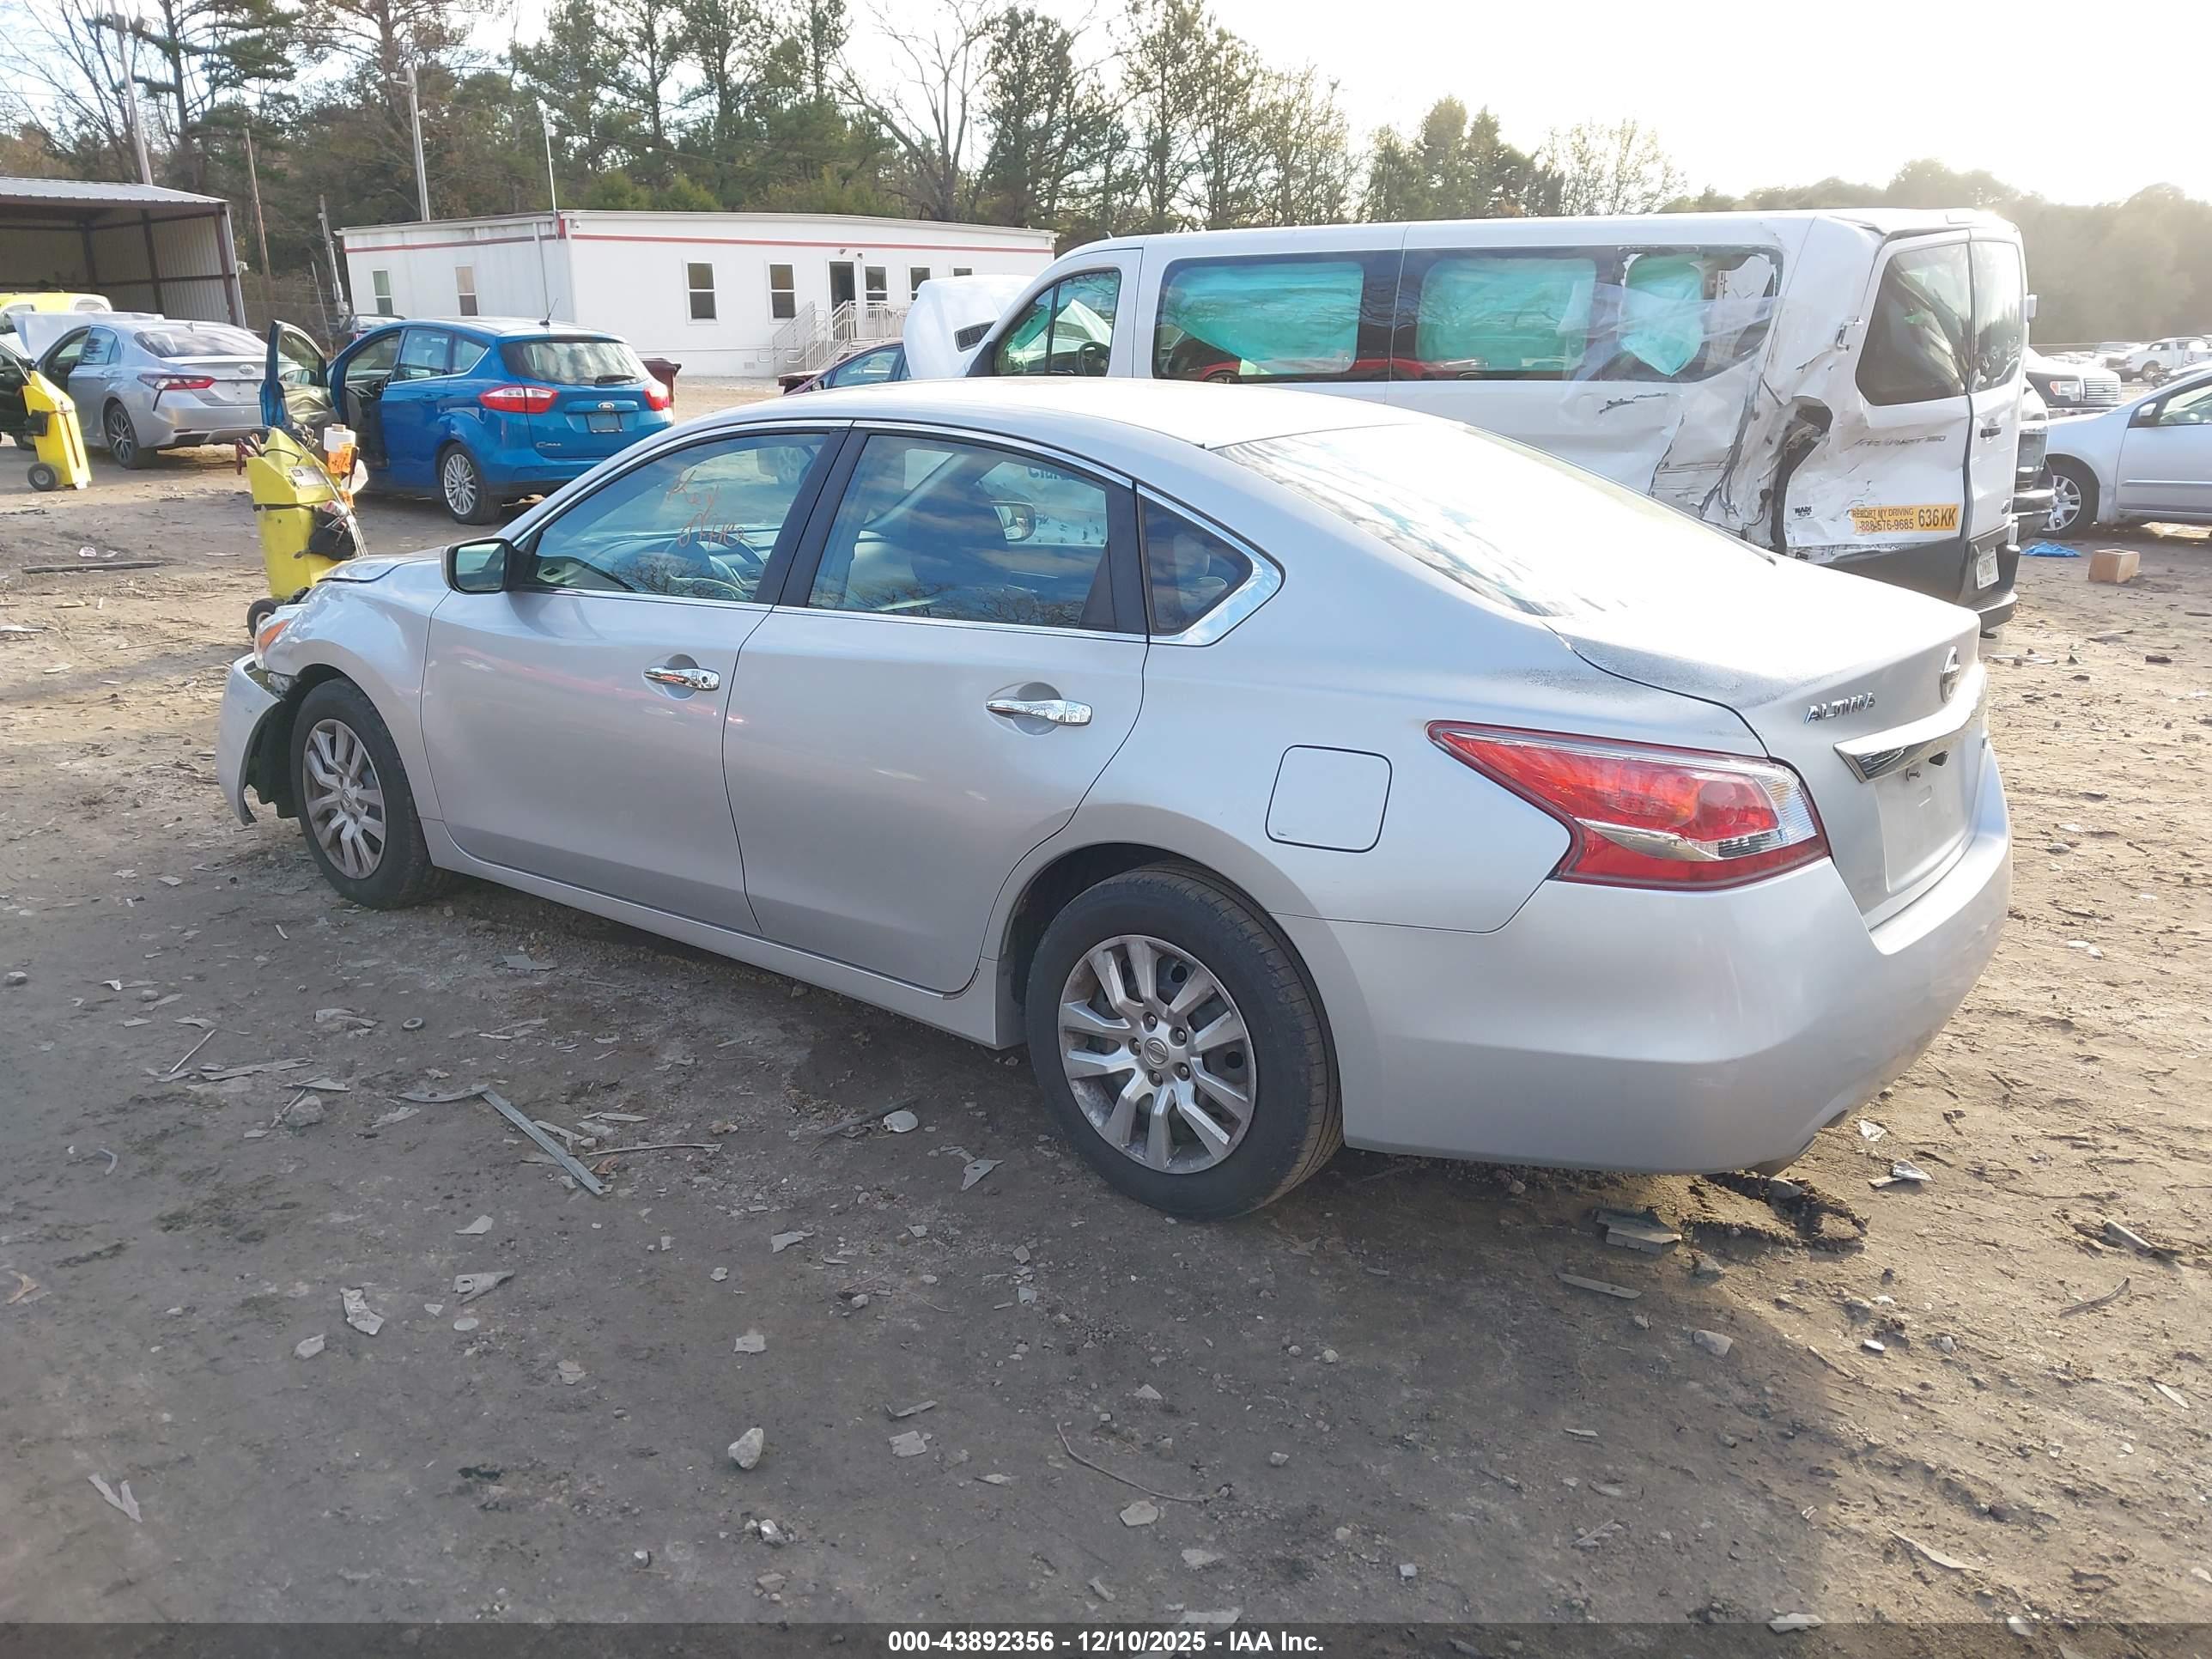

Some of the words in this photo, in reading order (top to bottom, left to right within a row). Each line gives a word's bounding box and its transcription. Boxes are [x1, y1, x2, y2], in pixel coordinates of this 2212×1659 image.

[1878, 508, 1887, 519] MY
[1888, 507, 1914, 517] DRIVING
[1803, 691, 1876, 724] ALTIMA
